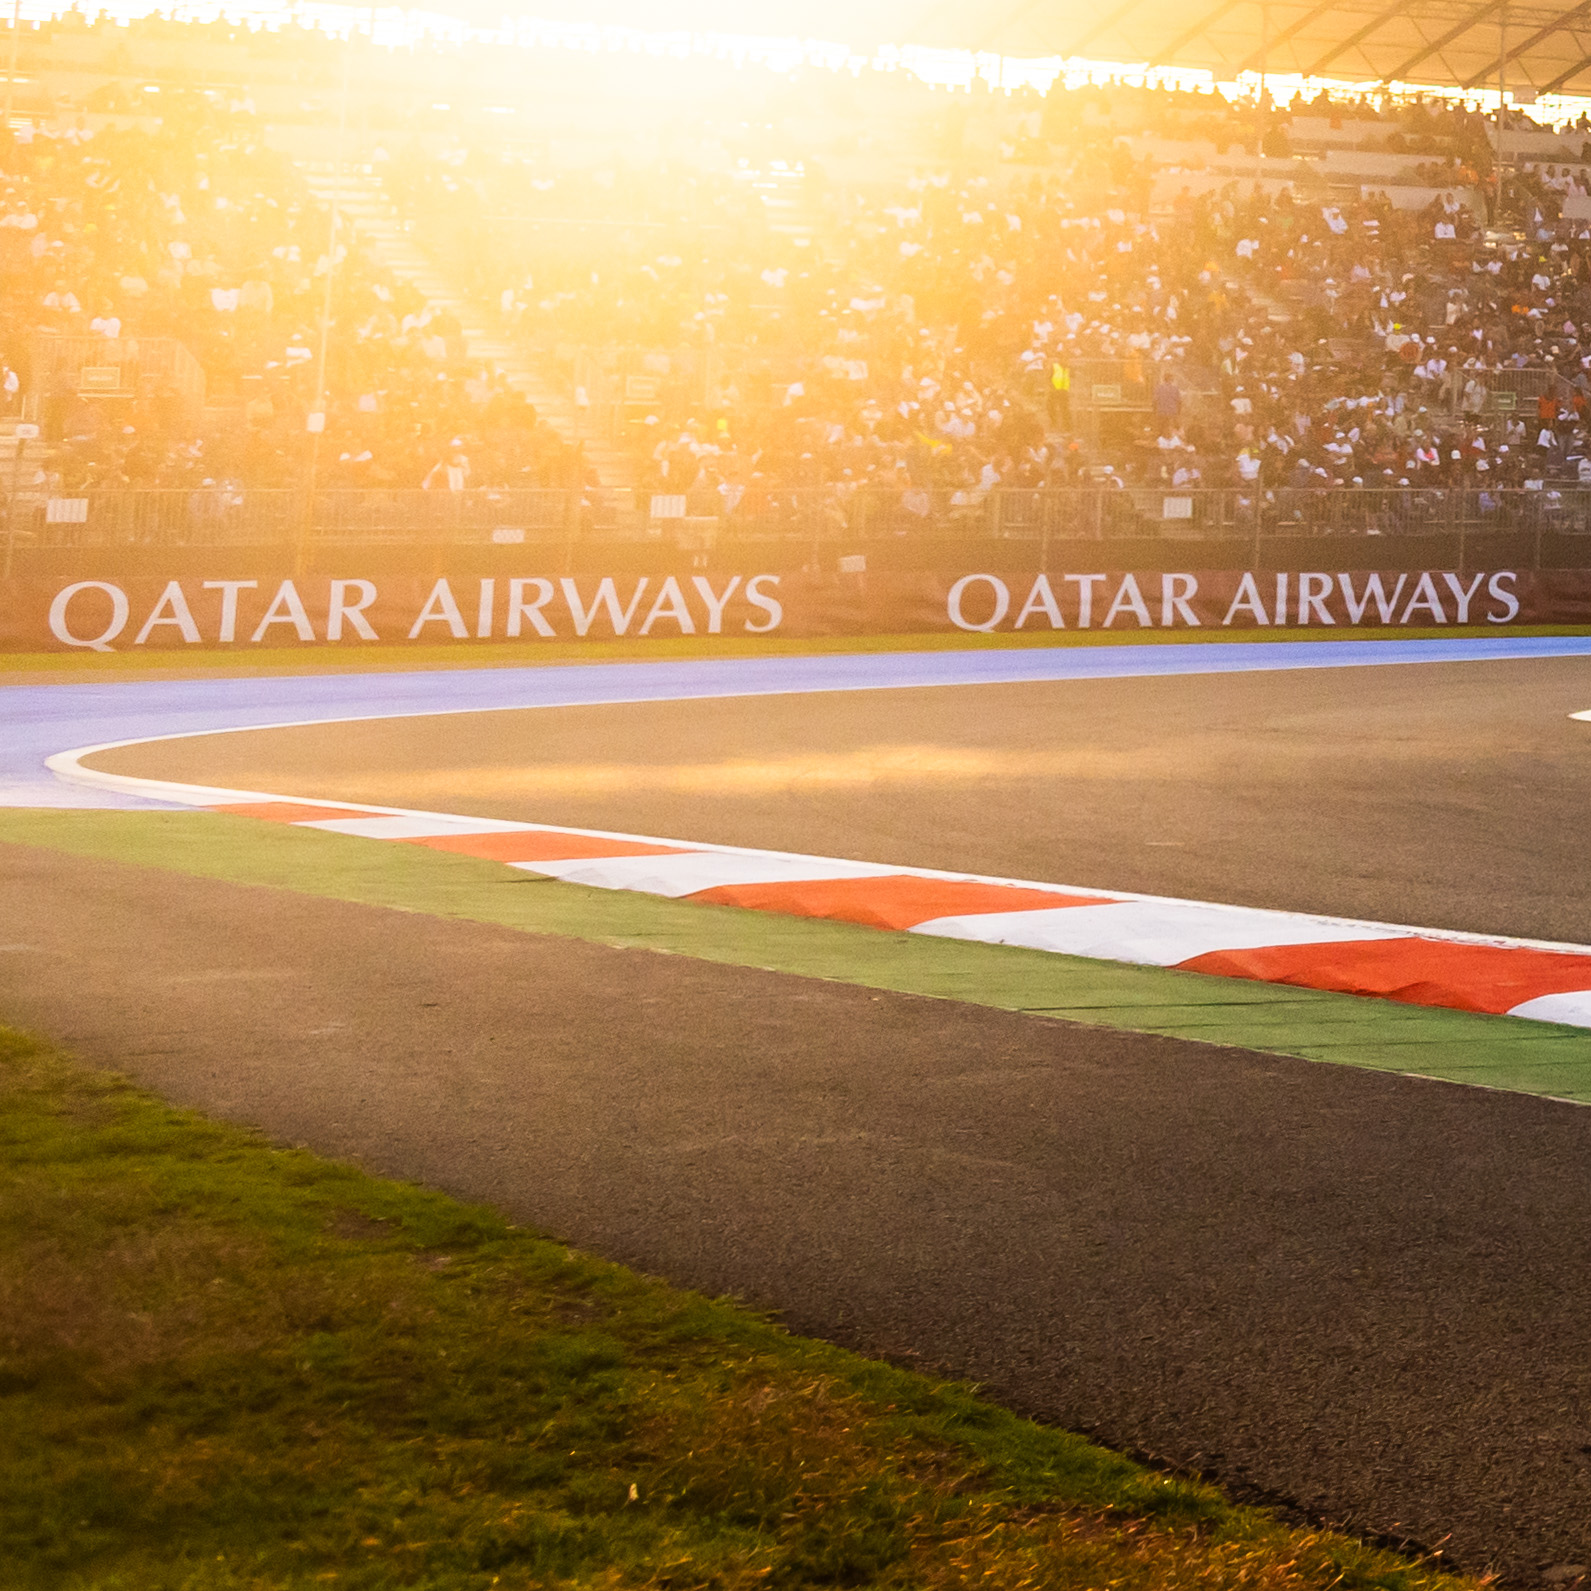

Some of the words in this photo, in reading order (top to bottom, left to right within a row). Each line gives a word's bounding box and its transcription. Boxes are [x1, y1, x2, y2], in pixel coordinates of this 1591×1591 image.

[48, 579, 380, 652] QATAR
[408, 574, 783, 639] AIRWAYS
[947, 573, 1200, 633] QATAR
[1222, 572, 1520, 627] AIRWAYS
